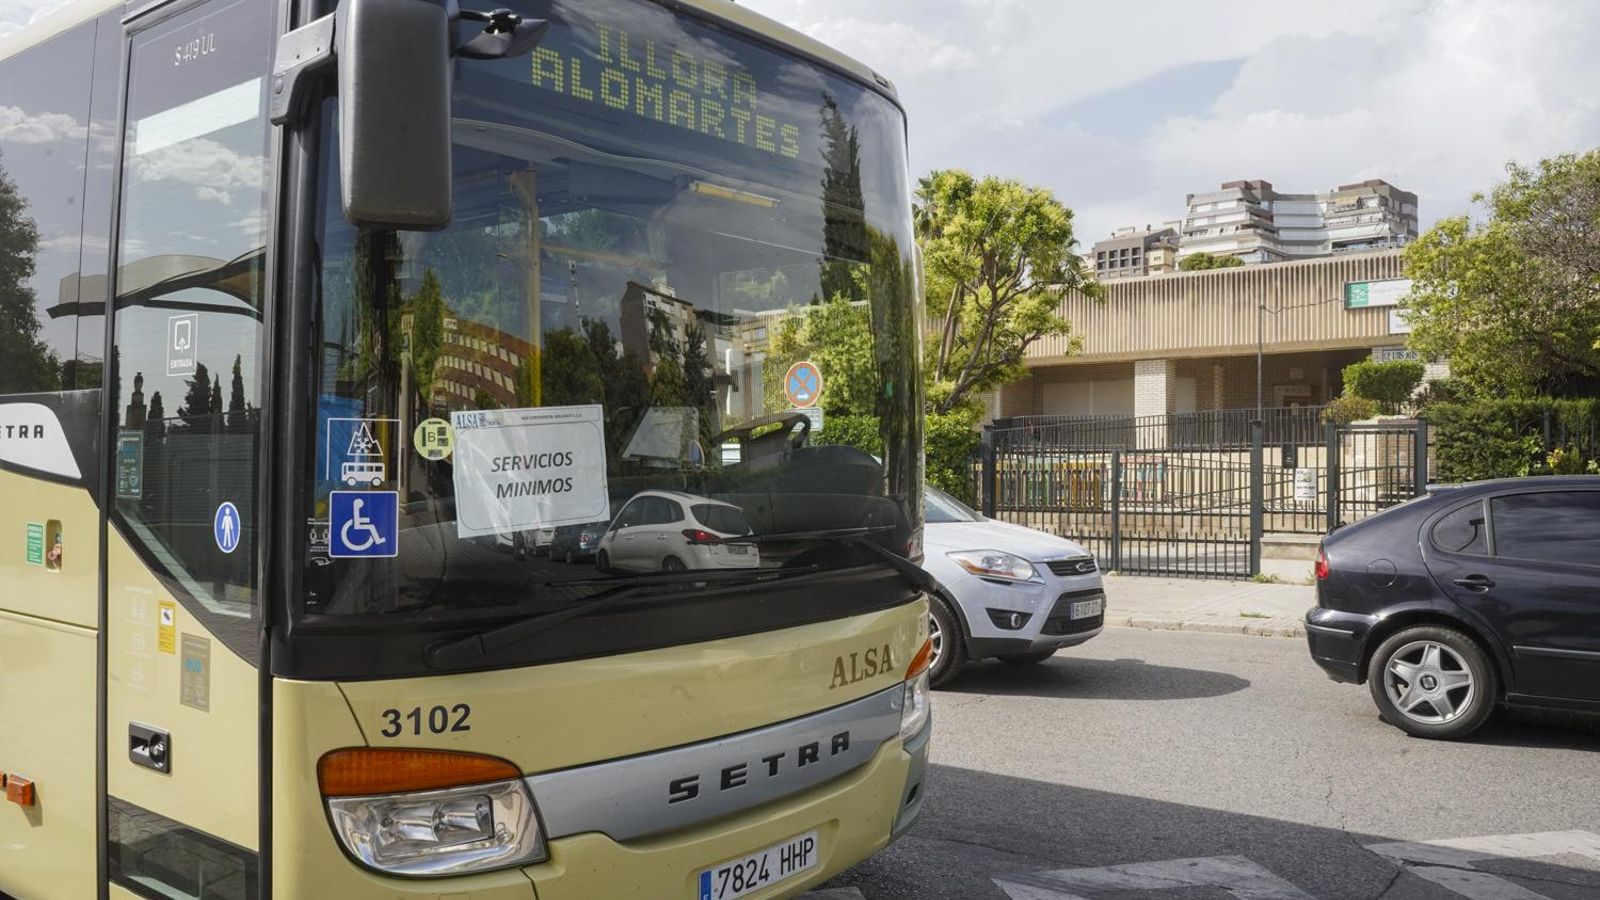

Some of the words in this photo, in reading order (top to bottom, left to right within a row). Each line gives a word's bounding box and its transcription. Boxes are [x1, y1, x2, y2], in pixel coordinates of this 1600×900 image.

[174, 46, 182, 66] S
[183, 39, 200, 62] 419
[202, 33, 216, 55] UL
[596, 22, 757, 111] ILLORA
[531, 46, 799, 158] ALOMARTES
[170, 358, 193, 369] ENTRADA
[0, 424, 44, 439] TRA
[428, 431, 436, 443] B
[455, 412, 479, 429] ALSA
[491, 451, 573, 473] SERVICIOS
[496, 477, 573, 499] MINIMOS
[829, 644, 894, 690] ALSA
[381, 703, 472, 737] 3102
[668, 730, 850, 805] SETRA
[718, 854, 770, 899] 7824
[780, 837, 814, 875] HHP
